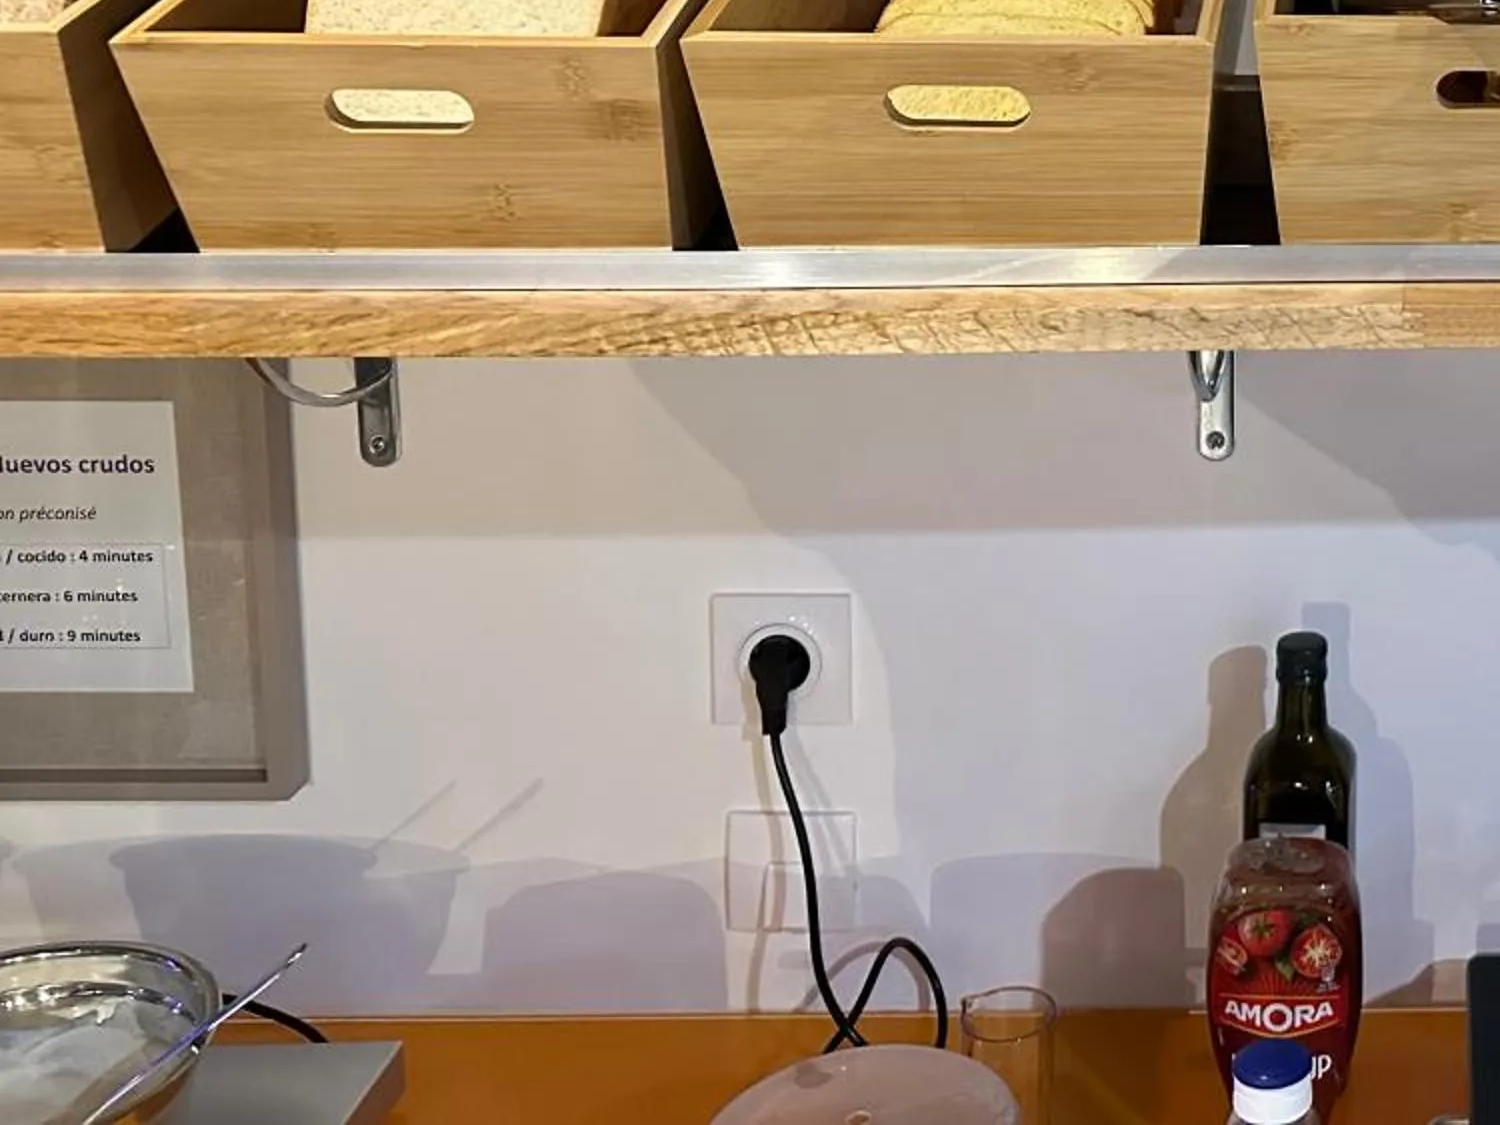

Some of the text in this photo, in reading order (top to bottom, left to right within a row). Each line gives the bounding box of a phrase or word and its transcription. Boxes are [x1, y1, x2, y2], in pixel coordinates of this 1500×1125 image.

[79, 455, 155, 474] crudos
[19, 506, 97, 523] préconisé
[17, 549, 66, 563] cocido
[79, 551, 88, 562] 4
[92, 550, 153, 563] minutes
[63, 590, 73, 602] 6
[77, 590, 139, 602] minutes
[19, 629, 55, 642] duro
[67, 630, 76, 642] 9
[81, 629, 141, 642] minutes
[1224, 1000, 1334, 1032] AMORA
